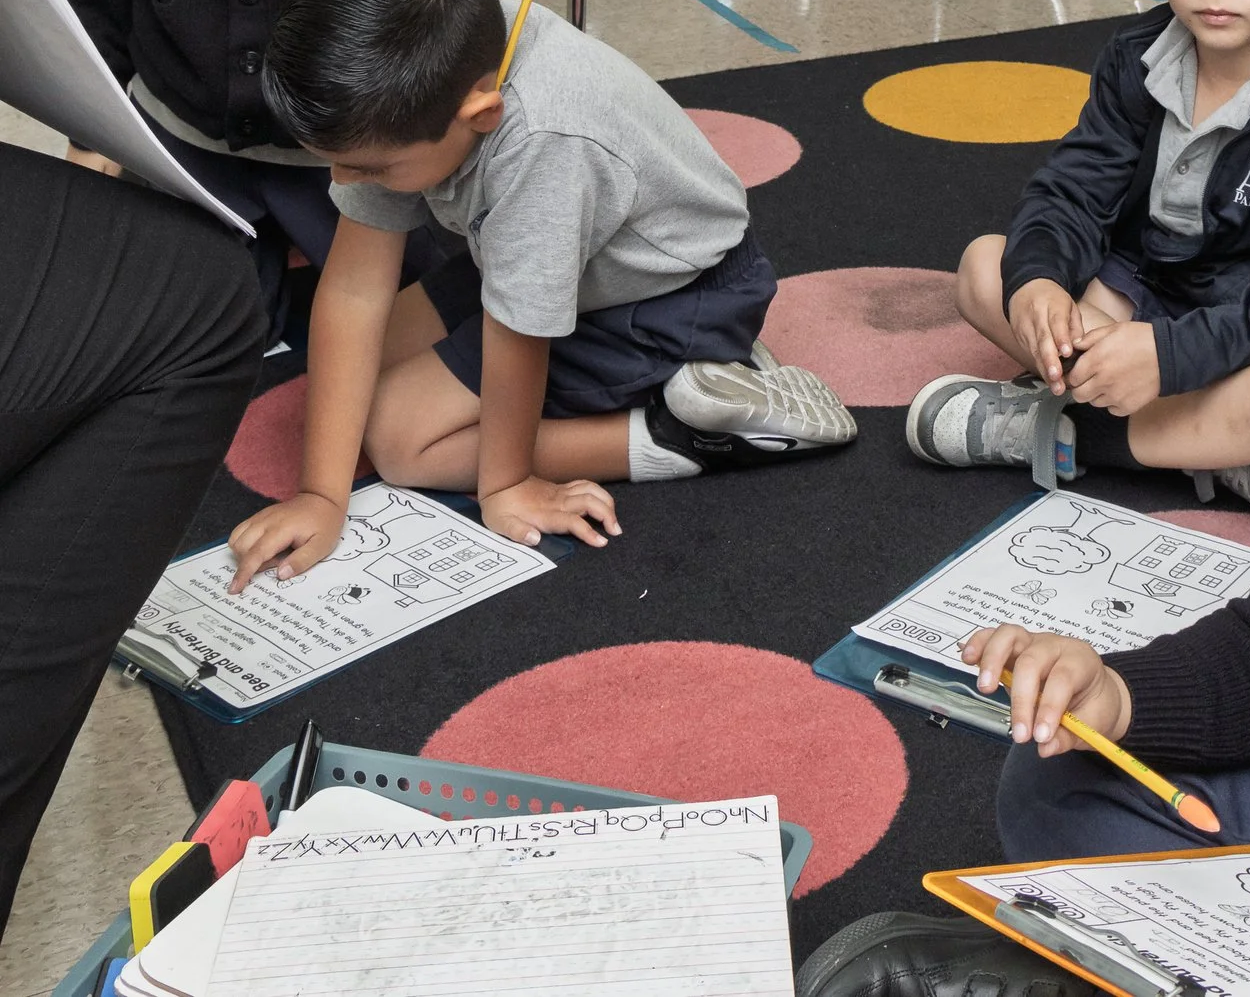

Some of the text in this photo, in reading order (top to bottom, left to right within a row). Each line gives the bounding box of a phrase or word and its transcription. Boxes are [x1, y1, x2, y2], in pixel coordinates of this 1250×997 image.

[218, 564, 237, 574] and
[206, 572, 224, 585] high
[252, 582, 276, 598] brown
[960, 583, 982, 593] and
[273, 593, 287, 603] the
[957, 592, 977, 605] high
[981, 590, 1010, 605] house
[259, 602, 270, 610] to
[285, 601, 303, 612] over
[976, 599, 992, 610] fly
[1009, 600, 1040, 616] brown
[188, 577, 313, 655] The yellow and black bee and the purple
[268, 606, 282, 618] like
[300, 608, 314, 619] fly
[941, 599, 1005, 625] nd the purple
[992, 605, 1015, 620] They
[1040, 611, 1057, 621] the
[279, 613, 314, 636] butterfly
[311, 614, 331, 630] They
[339, 614, 365, 629] green
[1034, 621, 1045, 629] to
[1058, 618, 1081, 628] over
[359, 627, 375, 638] the
[874, 617, 942, 649] and
[1046, 625, 1064, 636] like
[1081, 624, 1097, 635] fly
[1124, 628, 1157, 642] green
[311, 632, 329, 646] blue
[343, 634, 358, 646] the
[1097, 630, 1122, 646] They
[321, 641, 342, 652] and
[162, 619, 270, 692] Bee and Butterfly
[1123, 878, 1136, 886] in
[1145, 881, 1174, 894] and
[1109, 885, 1151, 906] purple
[1134, 885, 1161, 900] high
[1159, 900, 1180, 911] fly
[1173, 894, 1210, 915] house
[1147, 905, 1169, 918] the
[1164, 917, 1193, 931] and
[1179, 911, 1209, 928] They
[1208, 913, 1249, 934] brown
[1193, 931, 1219, 944] bee
[1234, 938, 1249, 946] to
